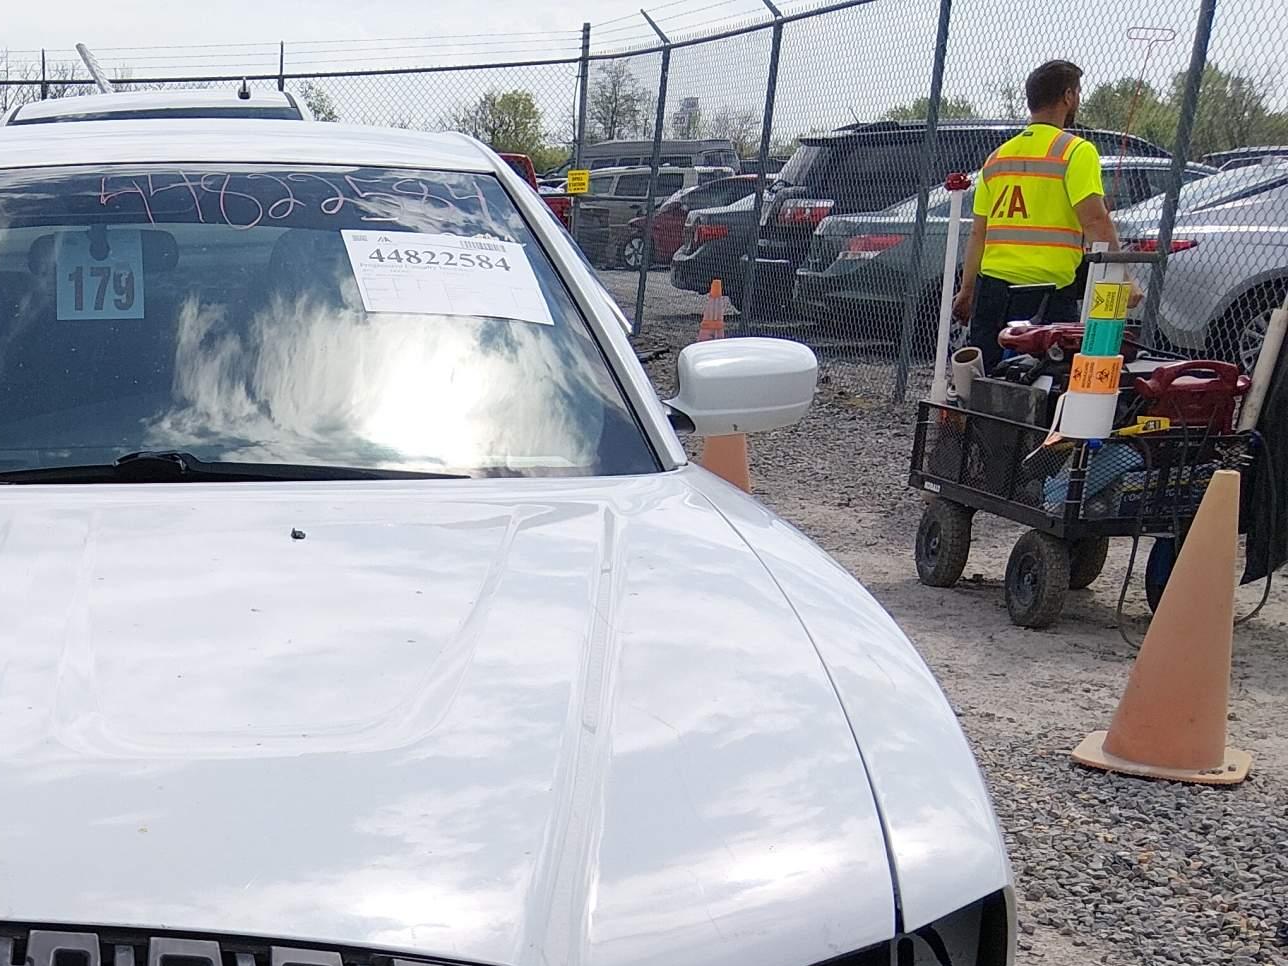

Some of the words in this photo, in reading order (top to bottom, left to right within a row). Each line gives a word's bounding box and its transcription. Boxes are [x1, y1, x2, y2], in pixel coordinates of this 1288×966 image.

[101, 169, 495, 229] 44822584
[368, 248, 512, 272] 44822584
[68, 265, 135, 311] 179
